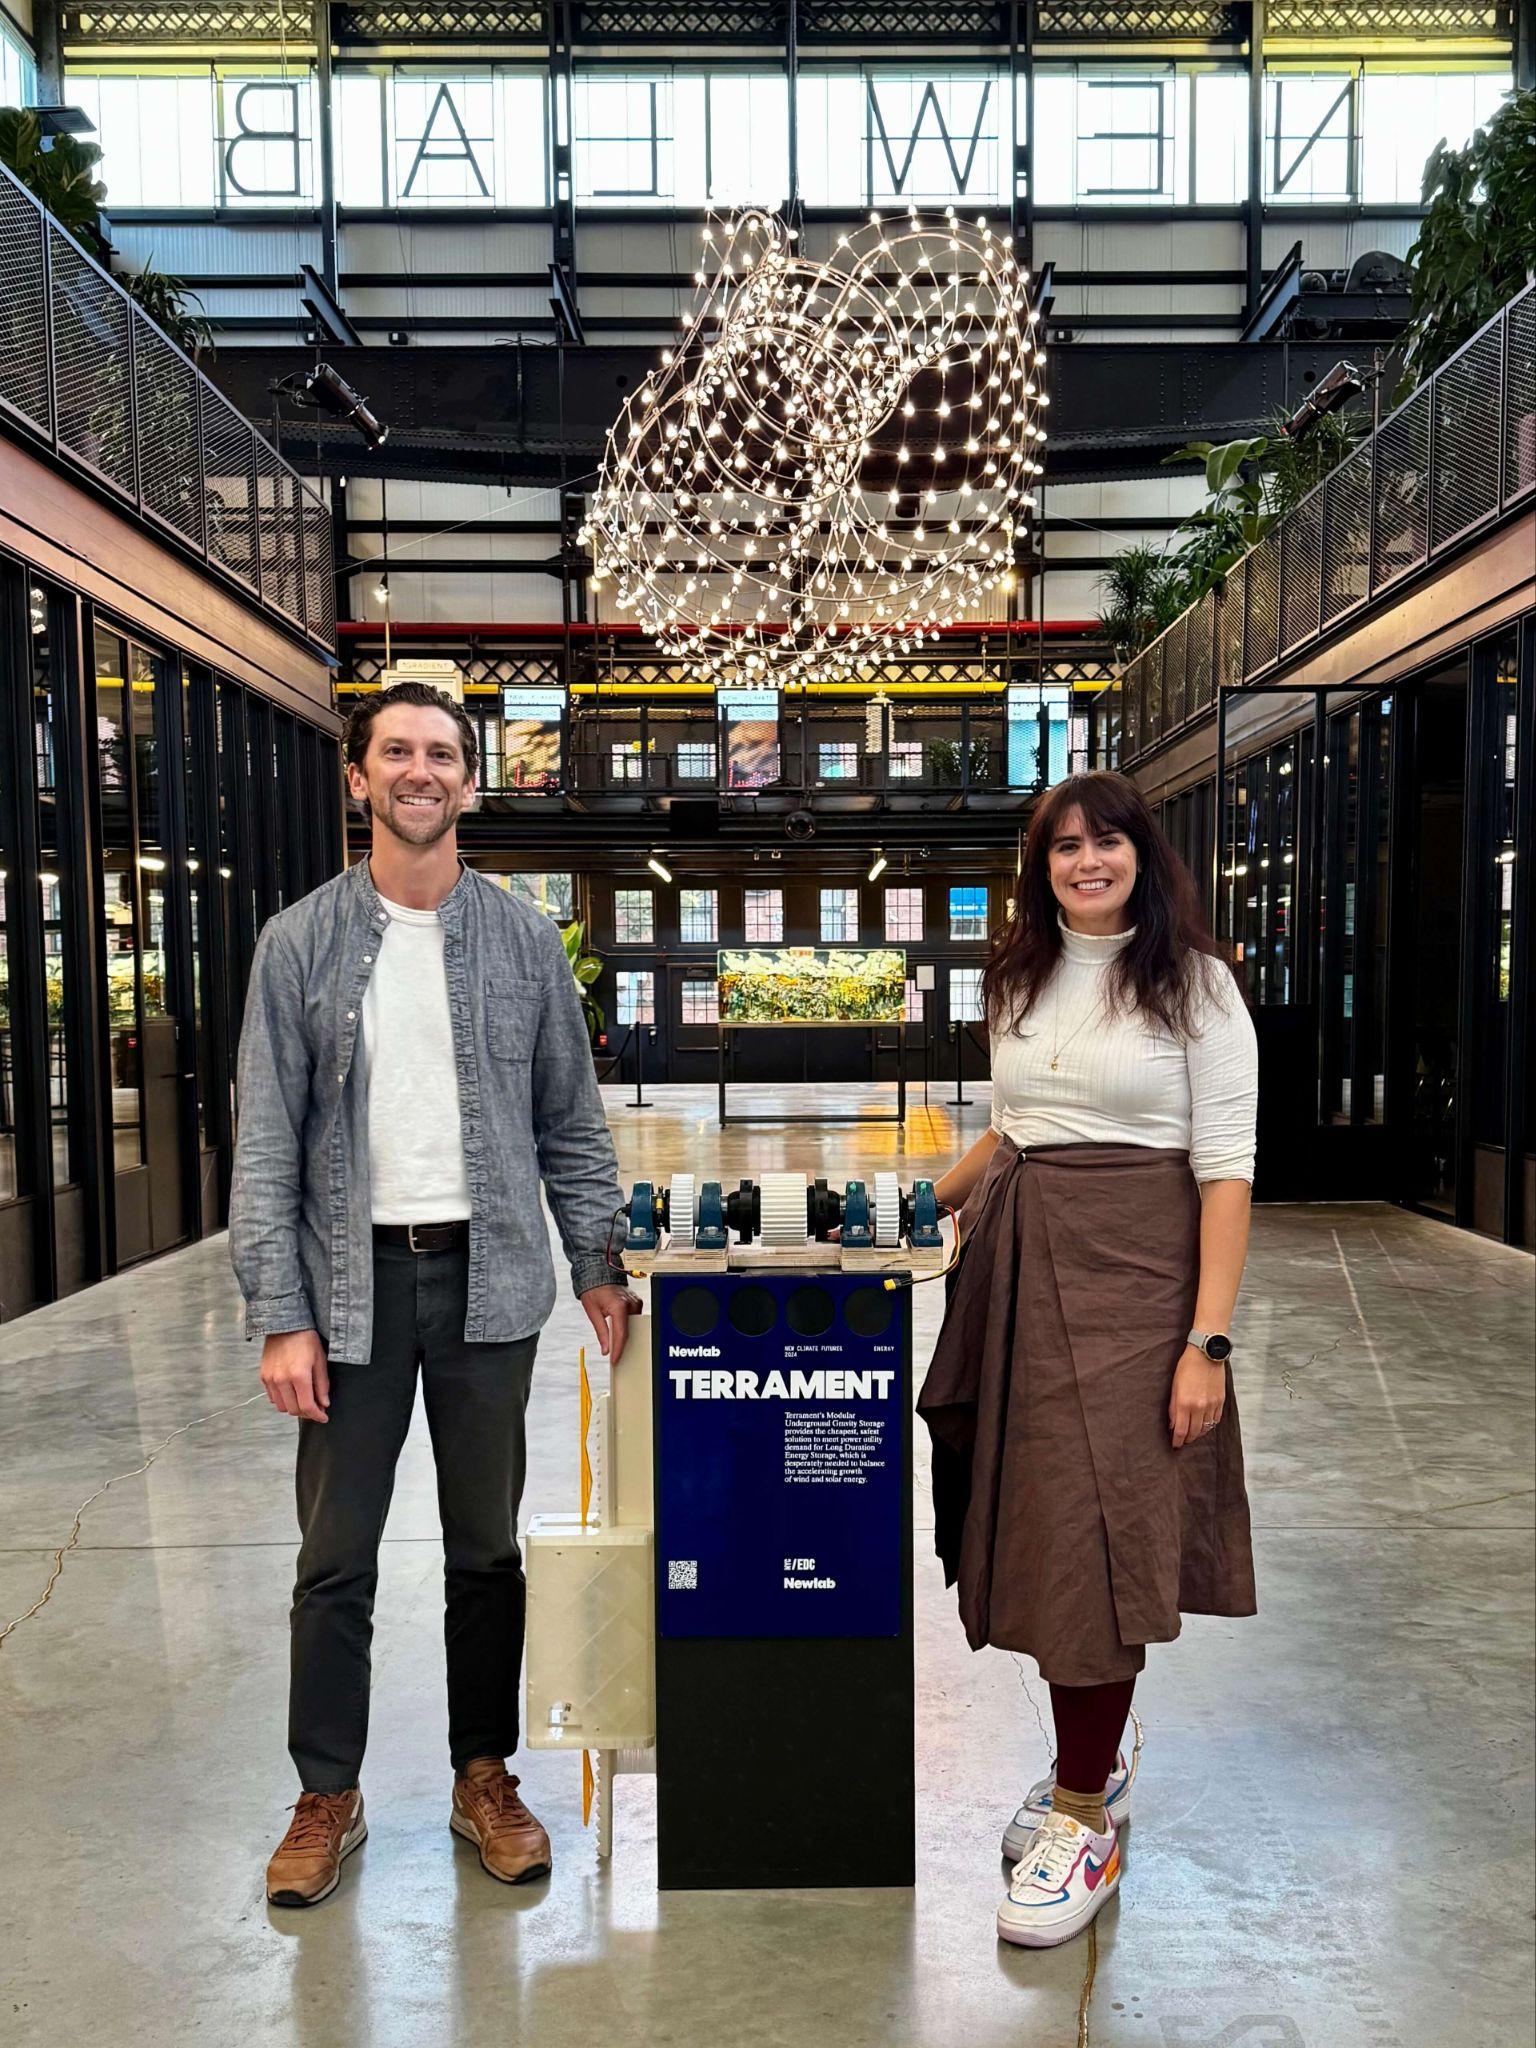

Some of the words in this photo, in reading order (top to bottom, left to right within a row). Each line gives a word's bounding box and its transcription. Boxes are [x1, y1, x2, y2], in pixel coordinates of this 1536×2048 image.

[669, 1346, 721, 1357] Newlab
[669, 1370, 895, 1400] TERRAMENT
[785, 1420, 831, 1428] Underground
[832, 1420, 857, 1428] Gravity
[859, 1420, 885, 1428] Storage
[784, 1428, 813, 1437] provides
[827, 1428, 859, 1437] cheapest,
[863, 1436, 883, 1445] utility
[825, 1444, 843, 1453] Long
[784, 1452, 809, 1460] Energy
[810, 1452, 838, 1460] Storage,
[784, 1460, 823, 1469] desperately
[797, 1468, 838, 1477] accelerating
[839, 1468, 863, 1477] growth
[784, 1577, 836, 1589] Newlab
